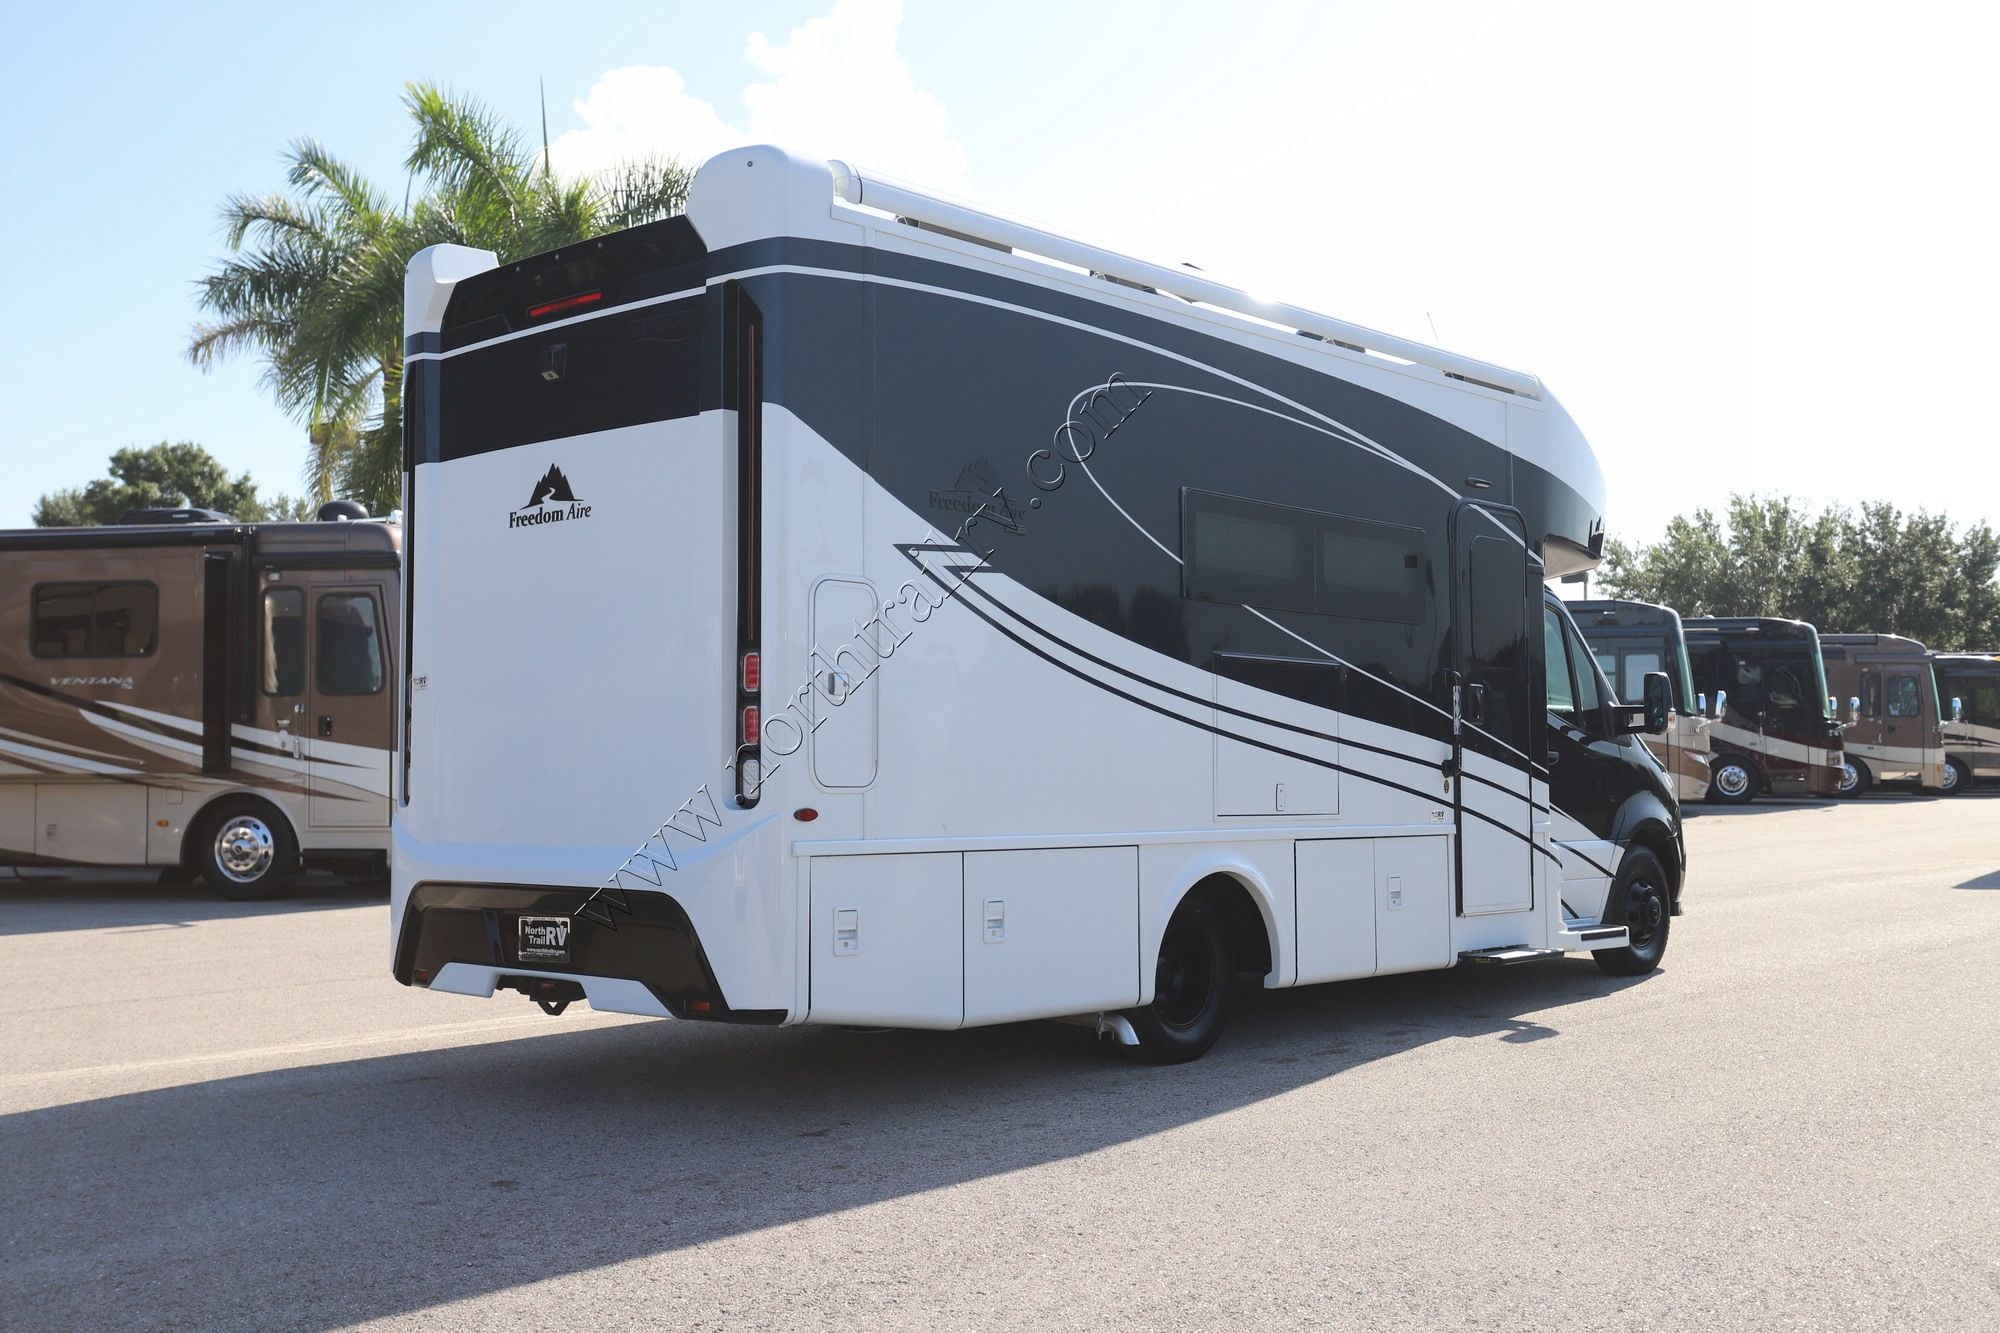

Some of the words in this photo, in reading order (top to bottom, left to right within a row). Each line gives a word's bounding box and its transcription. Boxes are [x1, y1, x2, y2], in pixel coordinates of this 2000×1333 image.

[928, 490, 994, 514] Freedom
[509, 507, 564, 528] Freedom
[566, 502, 592, 520] Aire
[50, 676, 133, 685] VENTANA
[525, 926, 545, 935] North
[546, 926, 567, 945] RV
[529, 936, 545, 944] Trail
